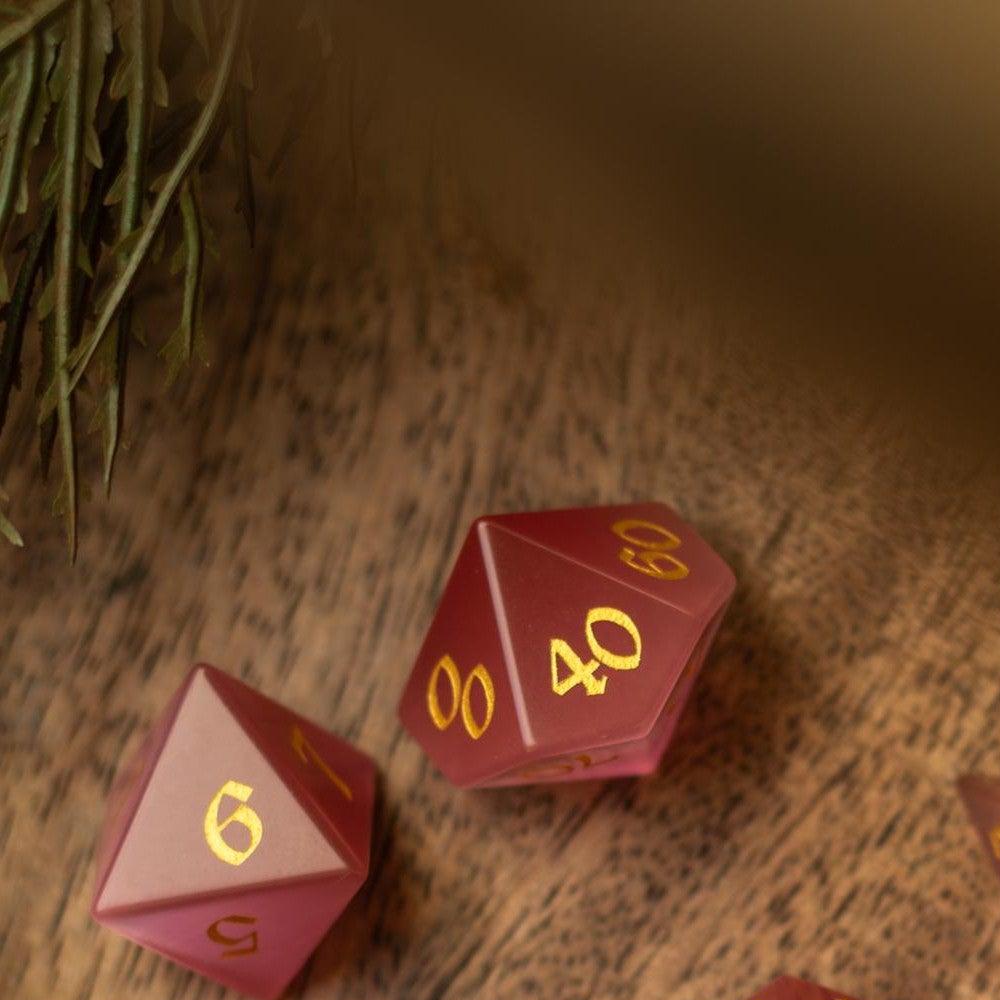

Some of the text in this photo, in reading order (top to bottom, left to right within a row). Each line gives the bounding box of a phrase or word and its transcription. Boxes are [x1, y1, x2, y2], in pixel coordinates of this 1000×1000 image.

[610, 519, 690, 580] 60
[550, 606, 642, 696] 40
[427, 653, 495, 740] 00
[204, 780, 264, 867] 6
[206, 914, 259, 960] 5
